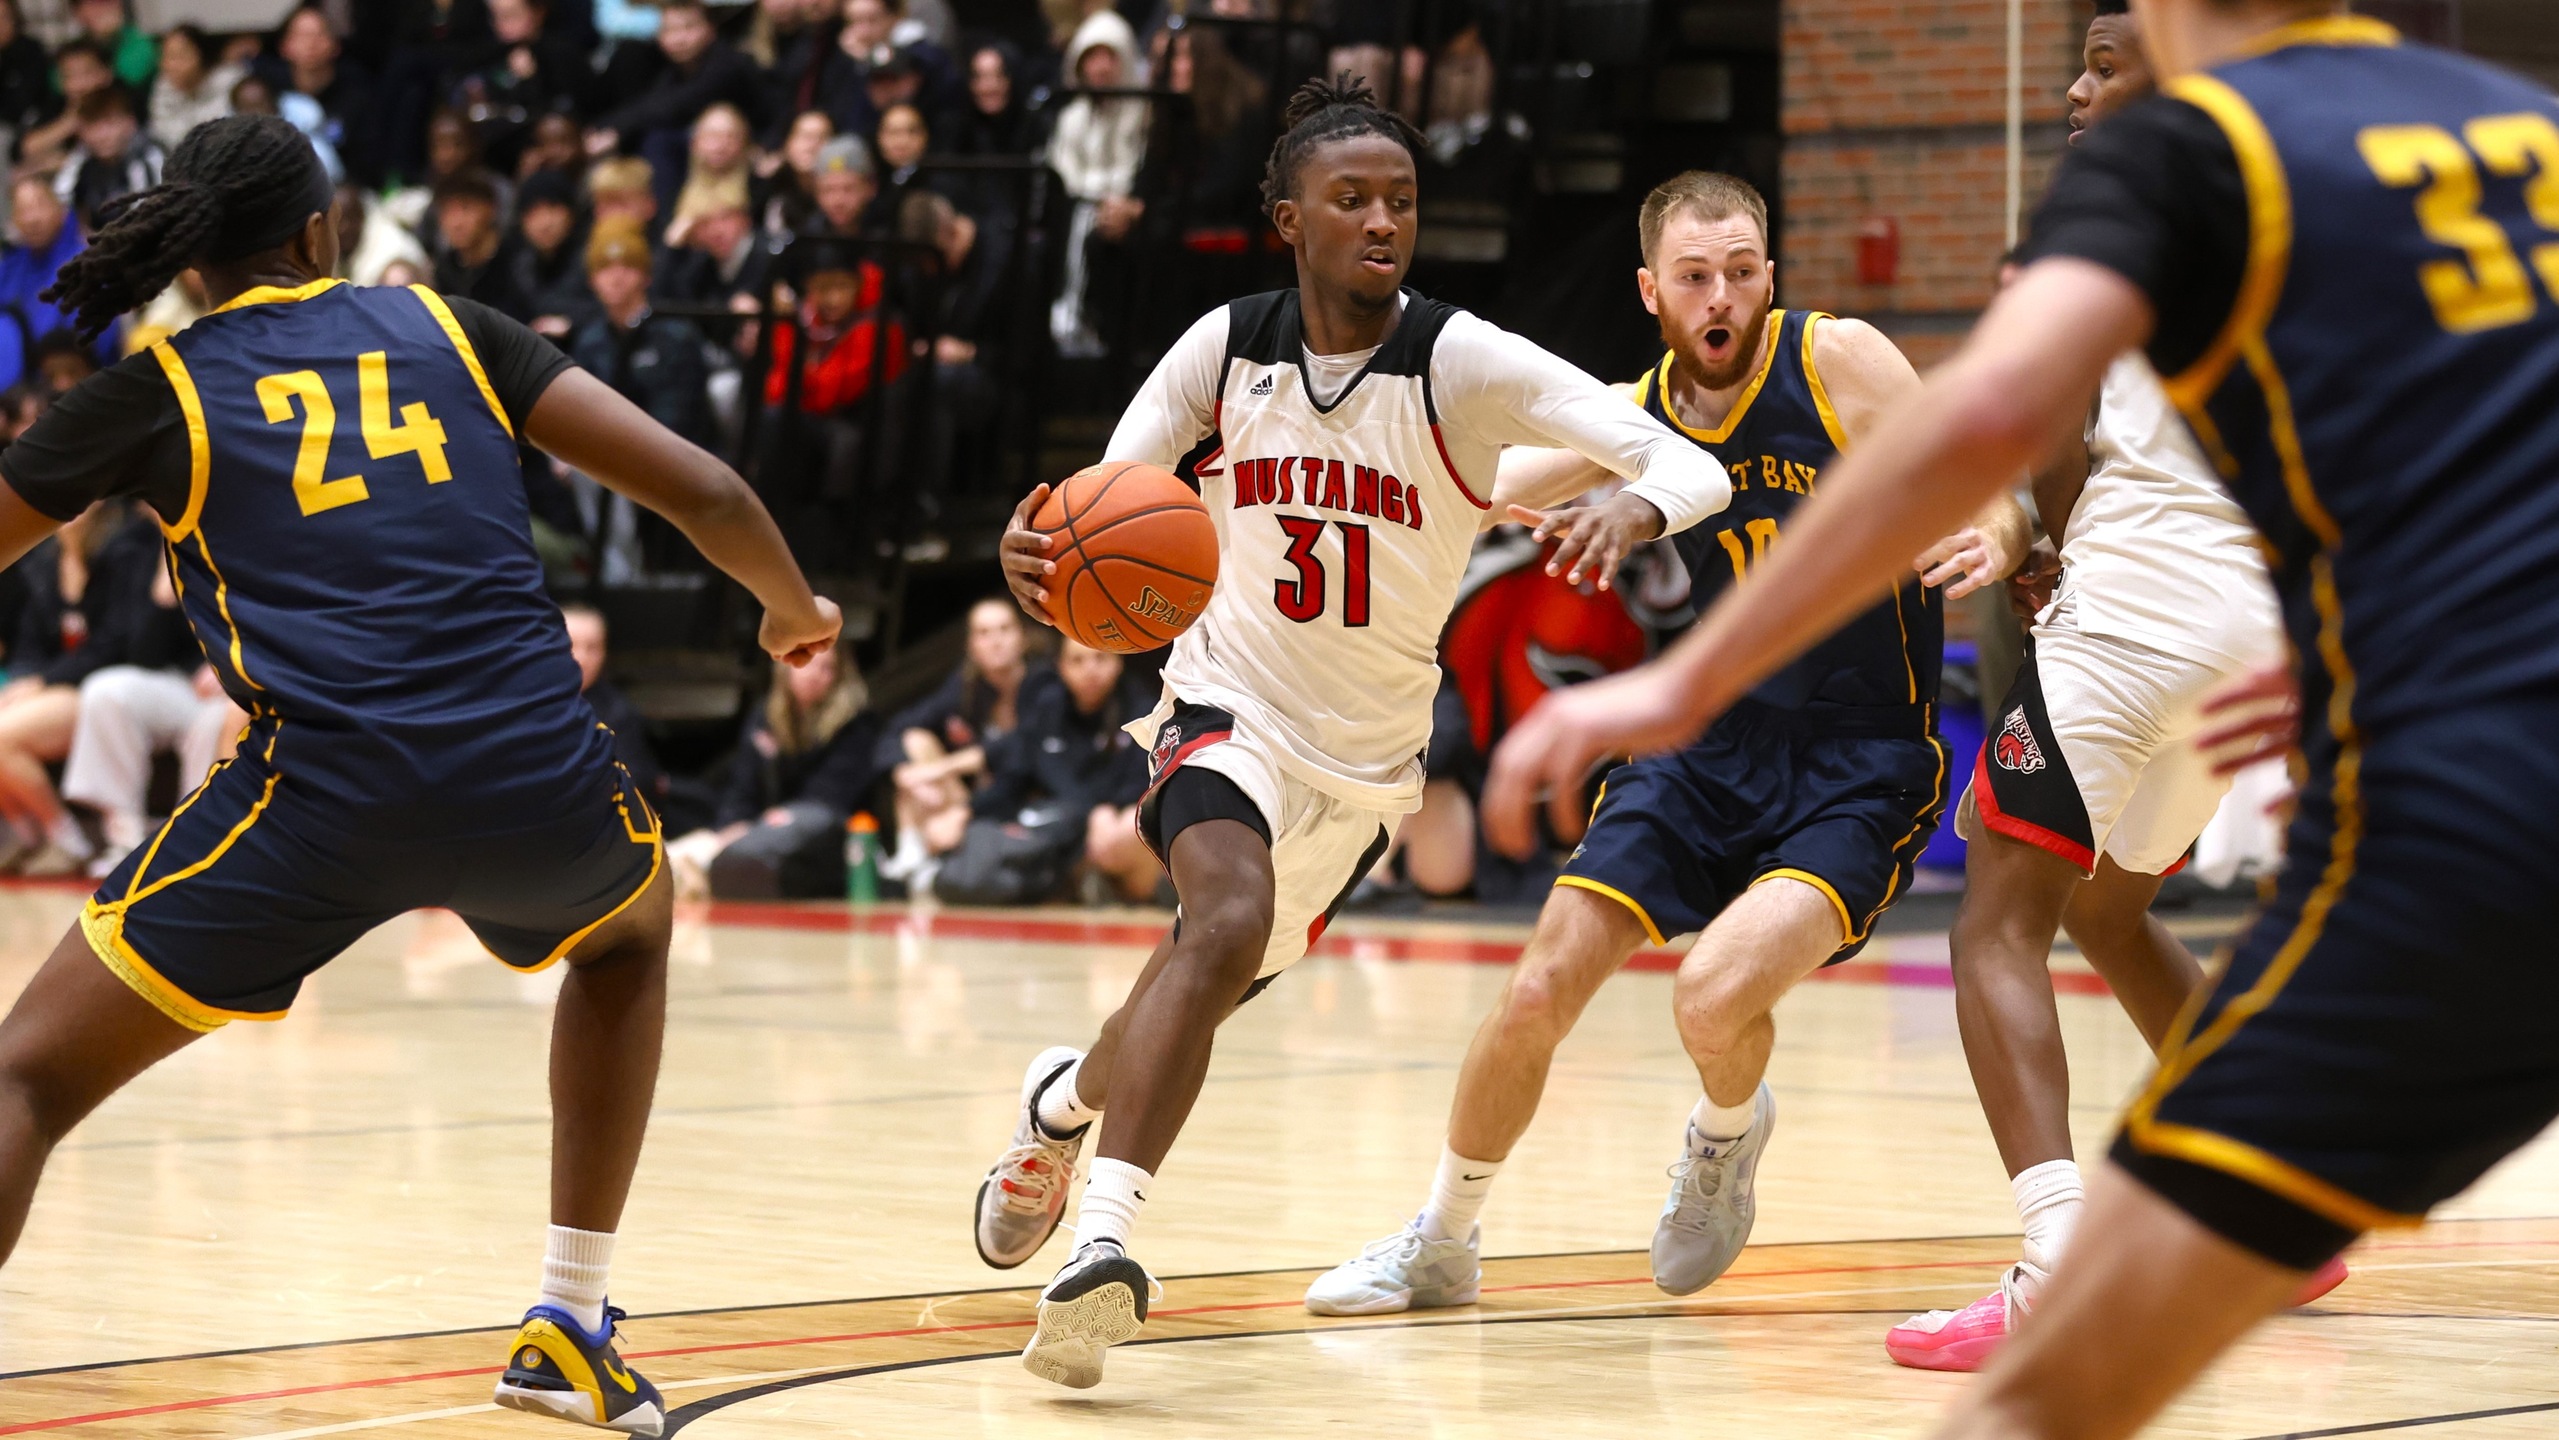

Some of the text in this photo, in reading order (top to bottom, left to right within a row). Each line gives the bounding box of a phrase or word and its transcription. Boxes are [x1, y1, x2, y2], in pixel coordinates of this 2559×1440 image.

[255, 350, 453, 517] 24
[1233, 456, 1422, 531] MUSTANGS
[1761, 455, 1817, 499] BAY
[1274, 513, 1370, 627] 31
[2004, 705, 2046, 774] MUSTANGS
